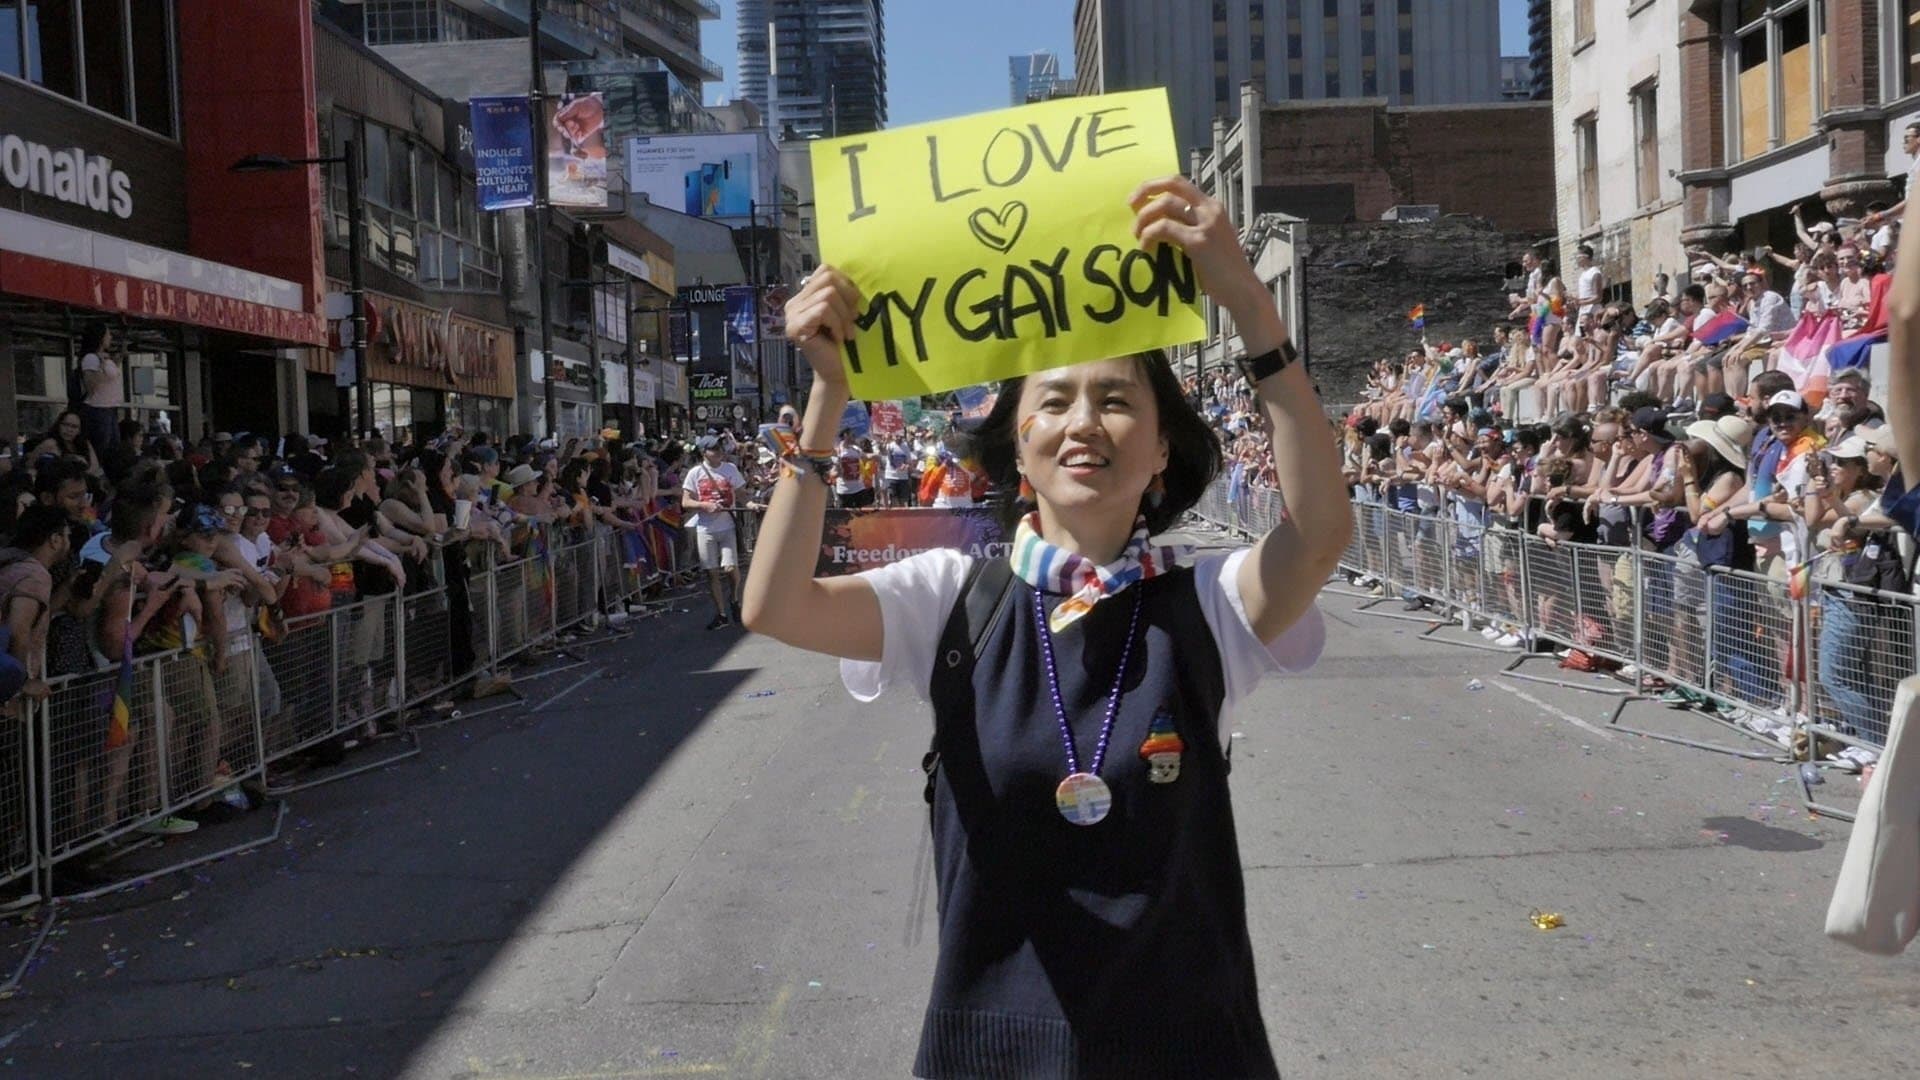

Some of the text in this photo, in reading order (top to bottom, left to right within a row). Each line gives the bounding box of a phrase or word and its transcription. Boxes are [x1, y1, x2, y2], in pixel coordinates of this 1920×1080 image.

[477, 147, 523, 159] INDULGE
[497, 158, 509, 167] IN
[841, 106, 1140, 222] I LOVE
[0, 133, 133, 219] onald's
[478, 165, 533, 177] TORONTO'S
[476, 174, 527, 187] CULTURAL
[496, 182, 530, 195] HEART
[689, 288, 727, 304] LOUNGE
[844, 241, 1198, 374] MY GAY SON
